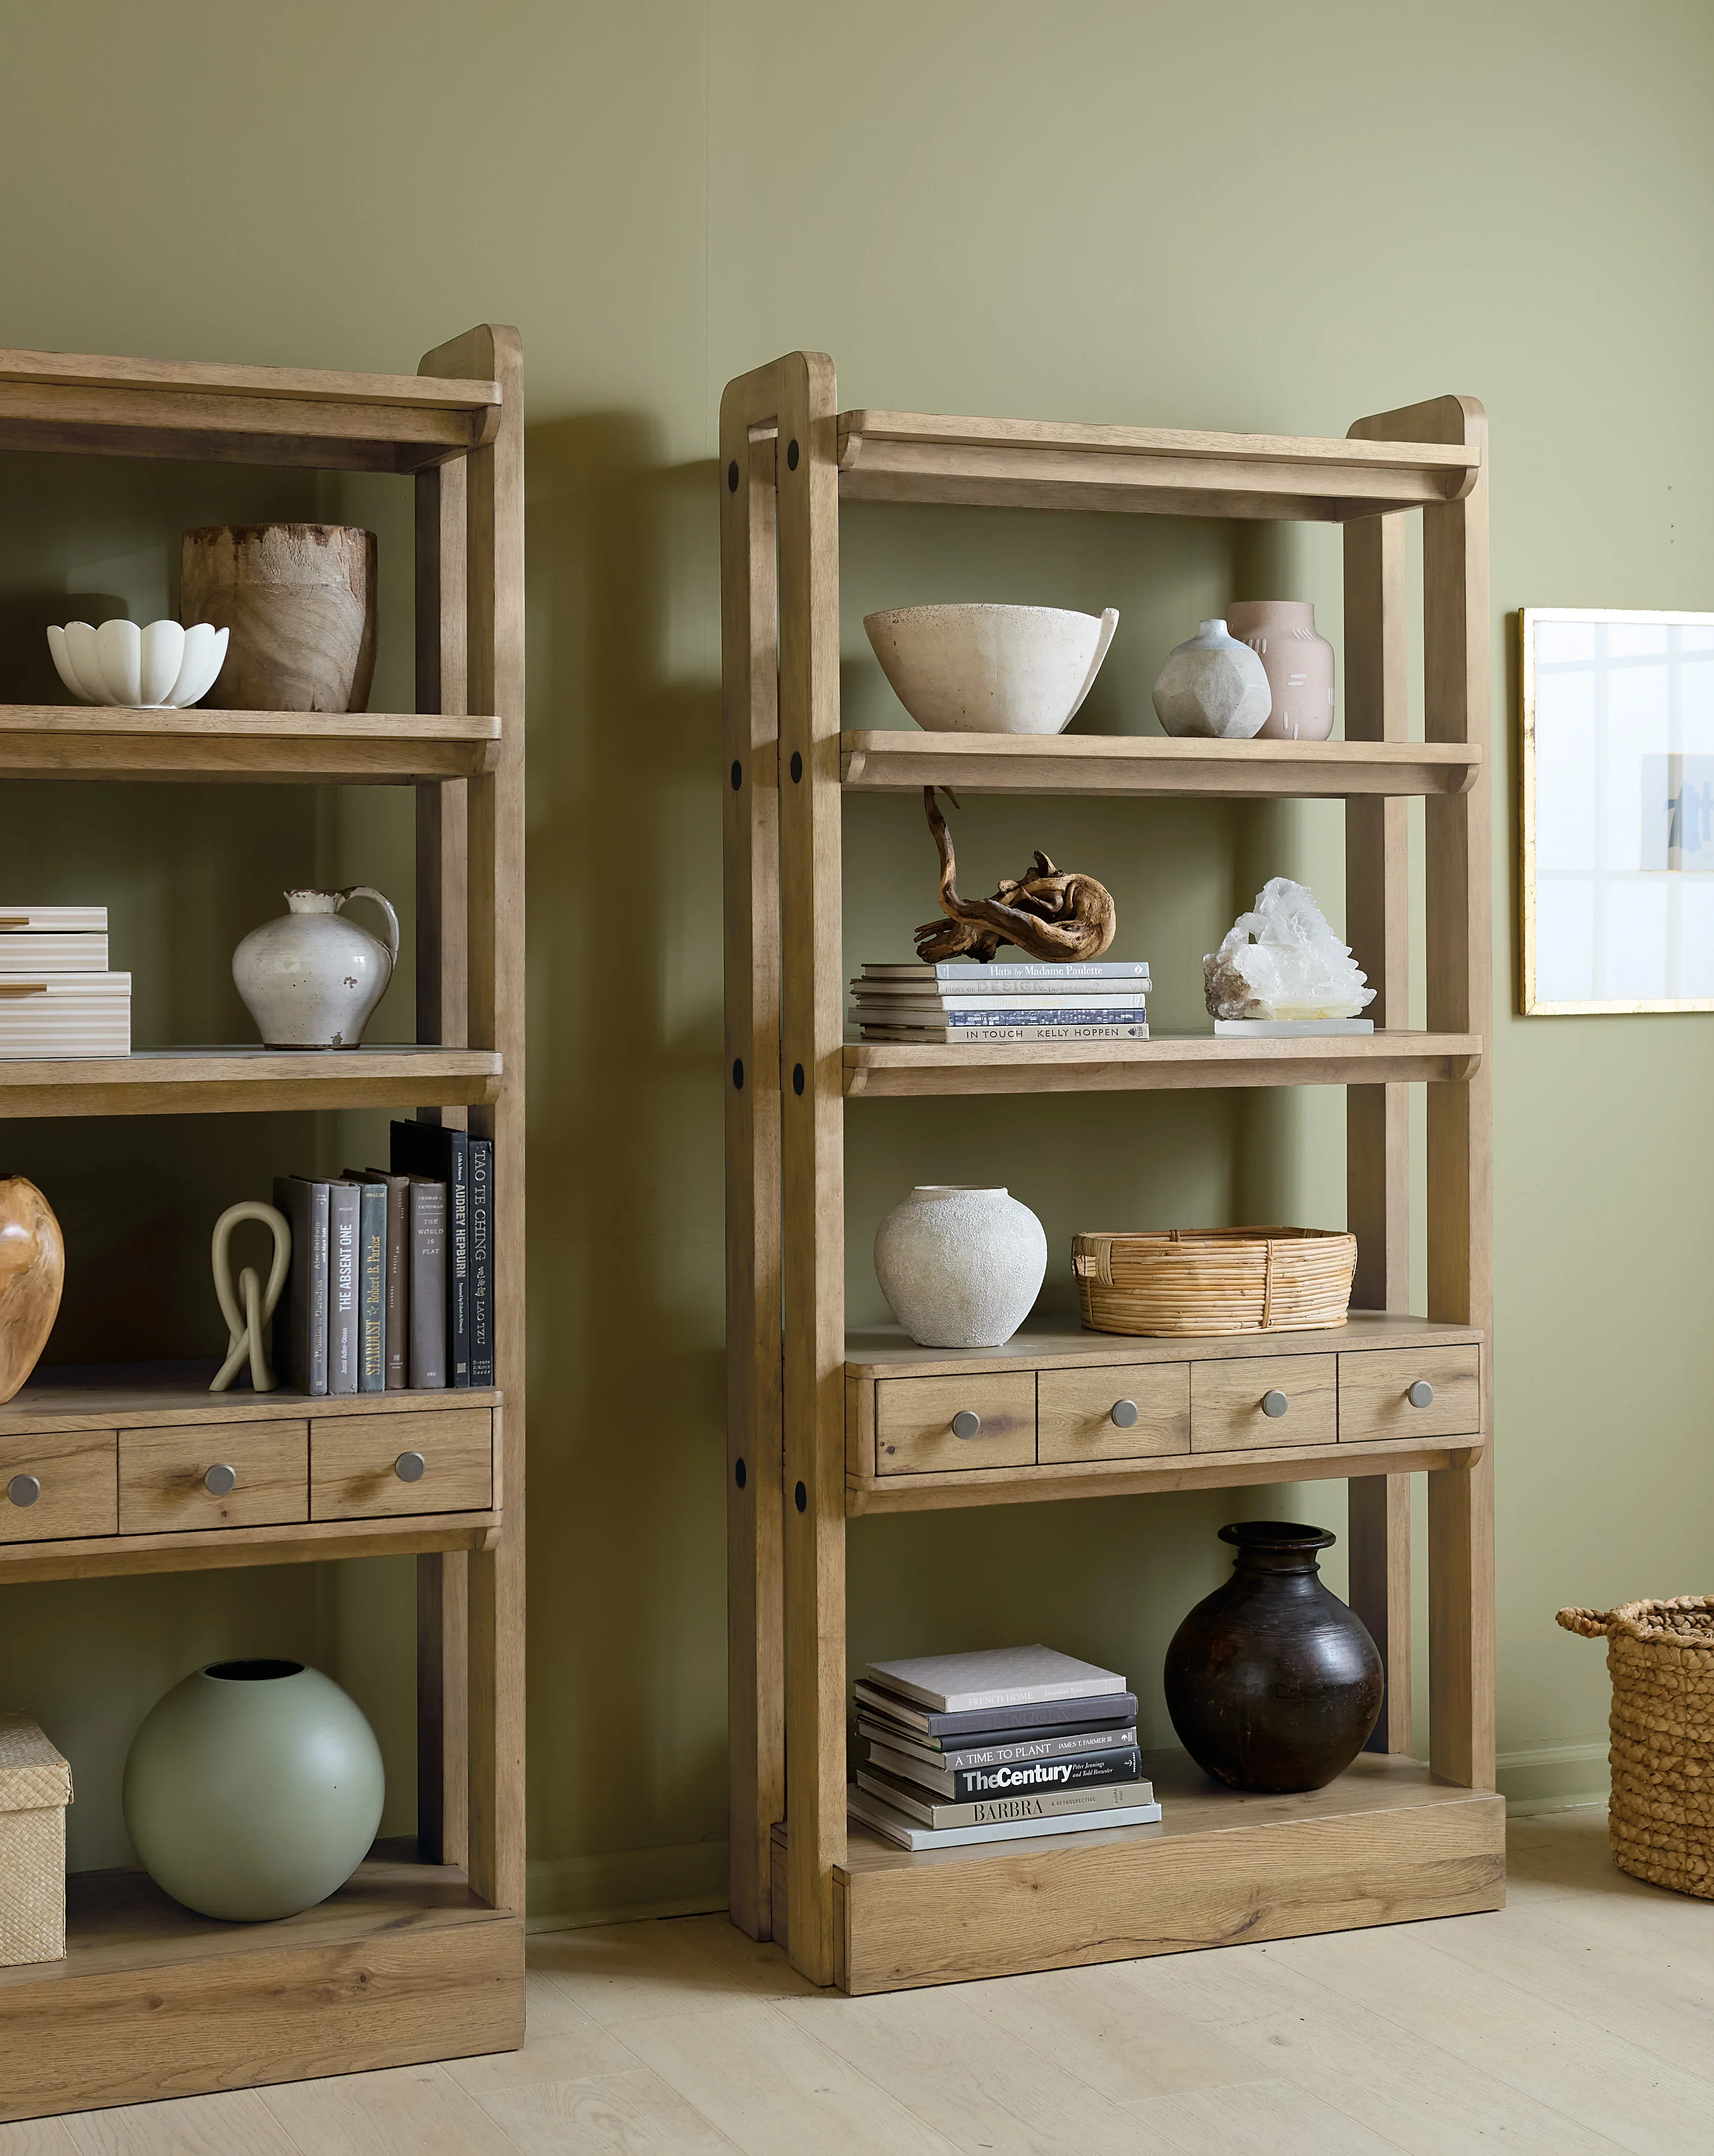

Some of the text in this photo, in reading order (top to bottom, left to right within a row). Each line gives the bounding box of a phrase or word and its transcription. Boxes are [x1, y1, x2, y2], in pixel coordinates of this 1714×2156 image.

[990, 965, 1103, 977] Hats by Madame Paulette
[977, 981, 1044, 992] DESIGN
[975, 999, 995, 1007] Maier
[1020, 998, 1068, 1008] Photographer
[982, 1030, 1023, 1038] TOUCH
[1038, 1028, 1119, 1037] KELLY HOPPEN
[475, 1150, 486, 1181] TAO
[475, 1185, 486, 1205] TE
[455, 1184, 466, 1278] AUDREY HEPBURN
[475, 1209, 486, 1260] CHING
[339, 1224, 352, 1312] THE ABSENT ONE
[367, 1235, 380, 1303] Robert B. Parker
[477, 1323, 485, 1344] TZU
[365, 1319, 380, 1375] STARDUST
[969, 1692, 1033, 1706] FRENCH HOME
[1044, 1687, 1084, 1697] Josephine Ryan
[1083, 1738, 1106, 1746] FARMER
[955, 1743, 1051, 1766] A TIME TO PLANT
[973, 1799, 1044, 1822] BARBRA
[1056, 1797, 1096, 1806] RETROSPECTIVE
